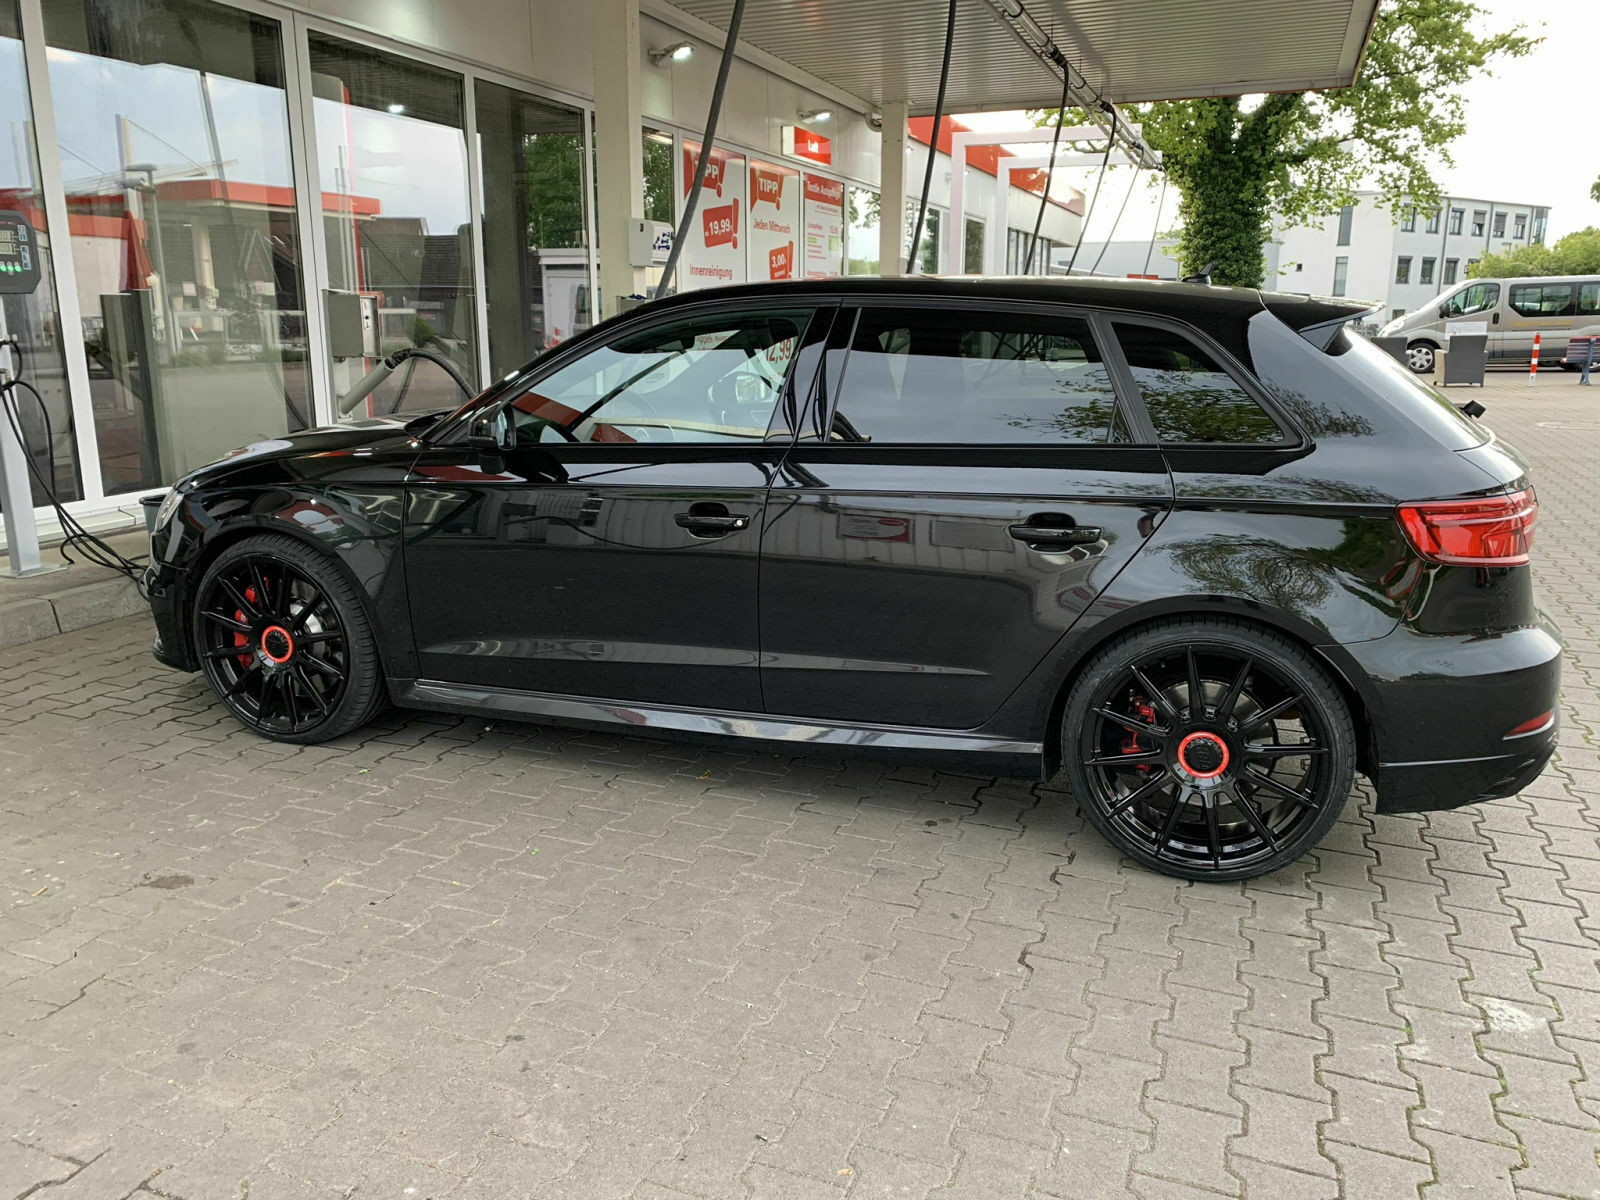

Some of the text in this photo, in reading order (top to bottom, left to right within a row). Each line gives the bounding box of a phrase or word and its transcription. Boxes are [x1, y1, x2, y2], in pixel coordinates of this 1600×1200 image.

[758, 177, 778, 194] TIPP
[709, 219, 731, 235] 19,99
[753, 218, 791, 234] Jeden Mittwoch
[690, 263, 733, 280] Innenreinigung
